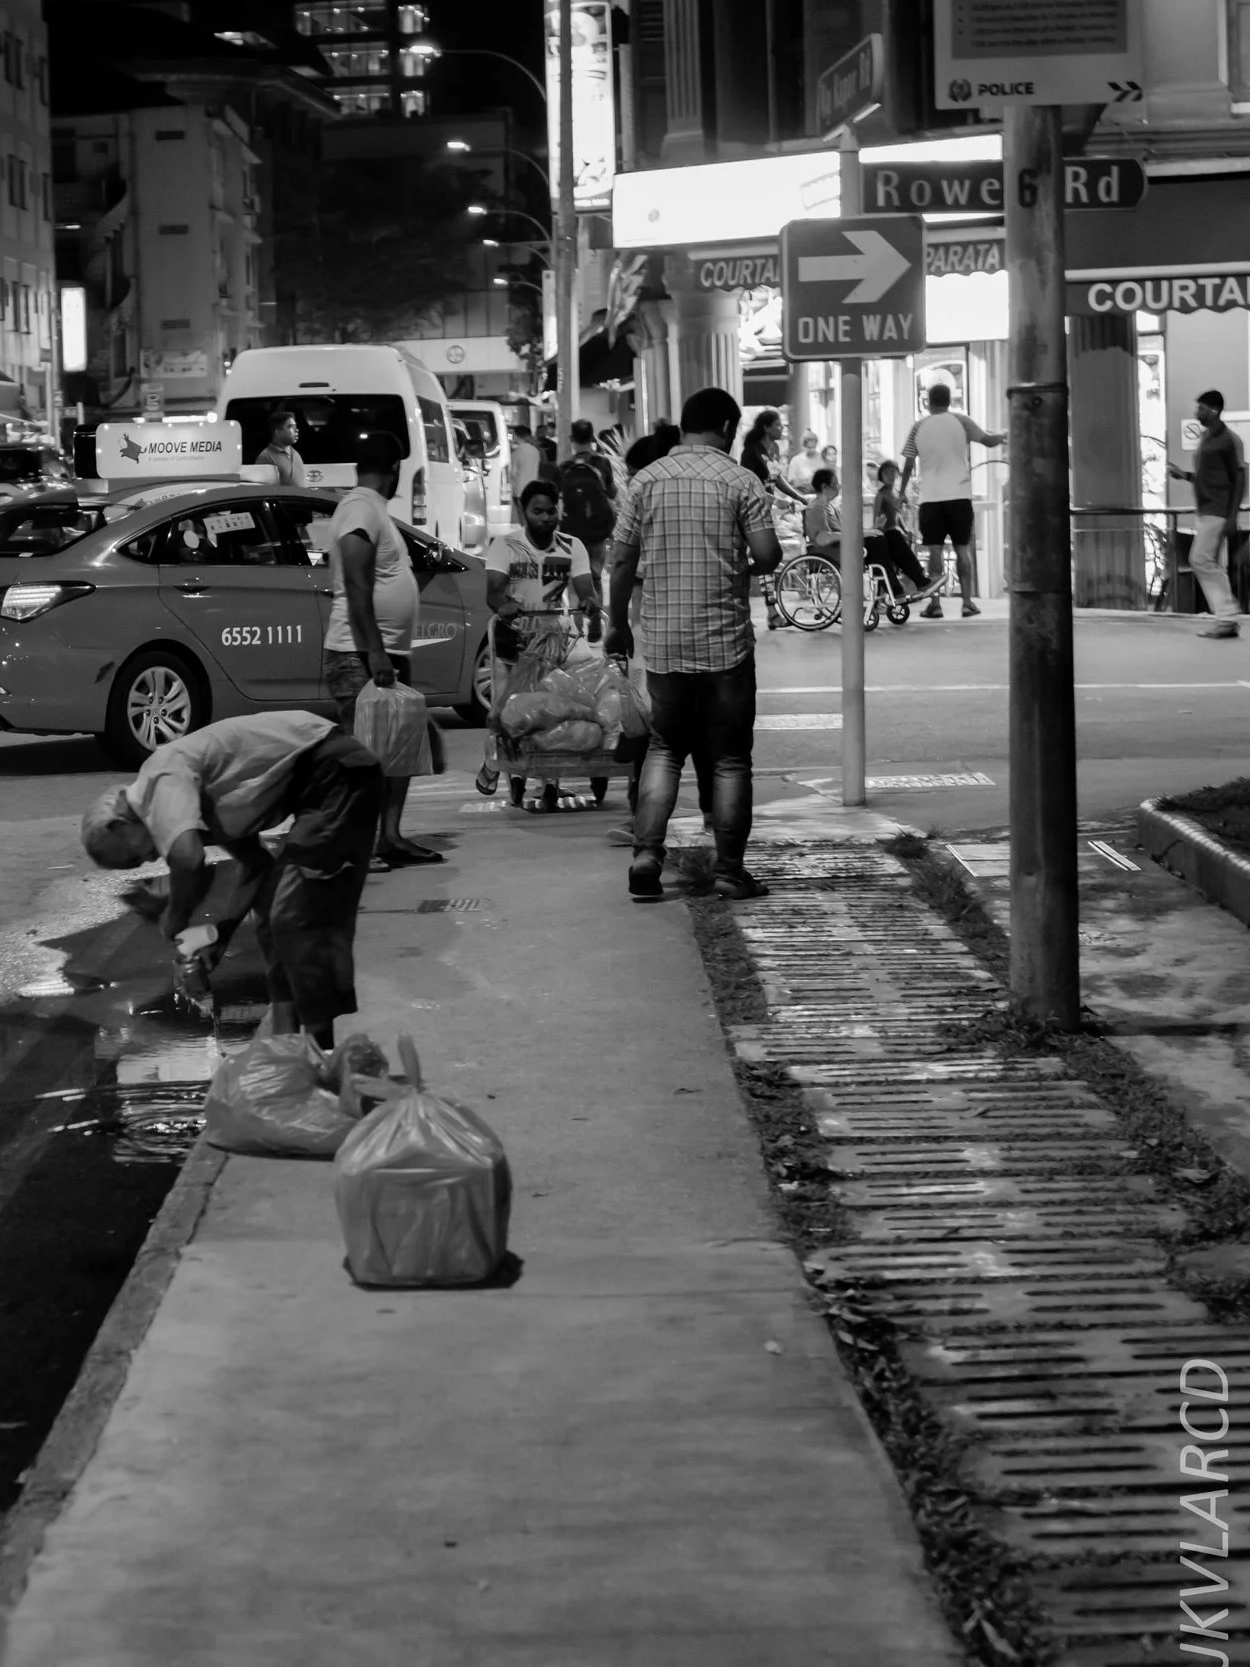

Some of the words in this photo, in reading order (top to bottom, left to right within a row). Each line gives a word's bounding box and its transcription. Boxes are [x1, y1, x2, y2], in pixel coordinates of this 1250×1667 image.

[978, 82, 1034, 96] POLICE
[876, 169, 1001, 207] Rowe
[1064, 165, 1120, 203] Rd
[1017, 168, 1038, 208] 6
[1087, 276, 1250, 312] COURTA
[798, 315, 851, 343] ONE
[862, 313, 913, 341] WAY
[148, 442, 187, 454] MOOVE
[190, 441, 222, 453] MEDIA
[221, 627, 261, 646] 6552
[266, 625, 302, 644] 1111
